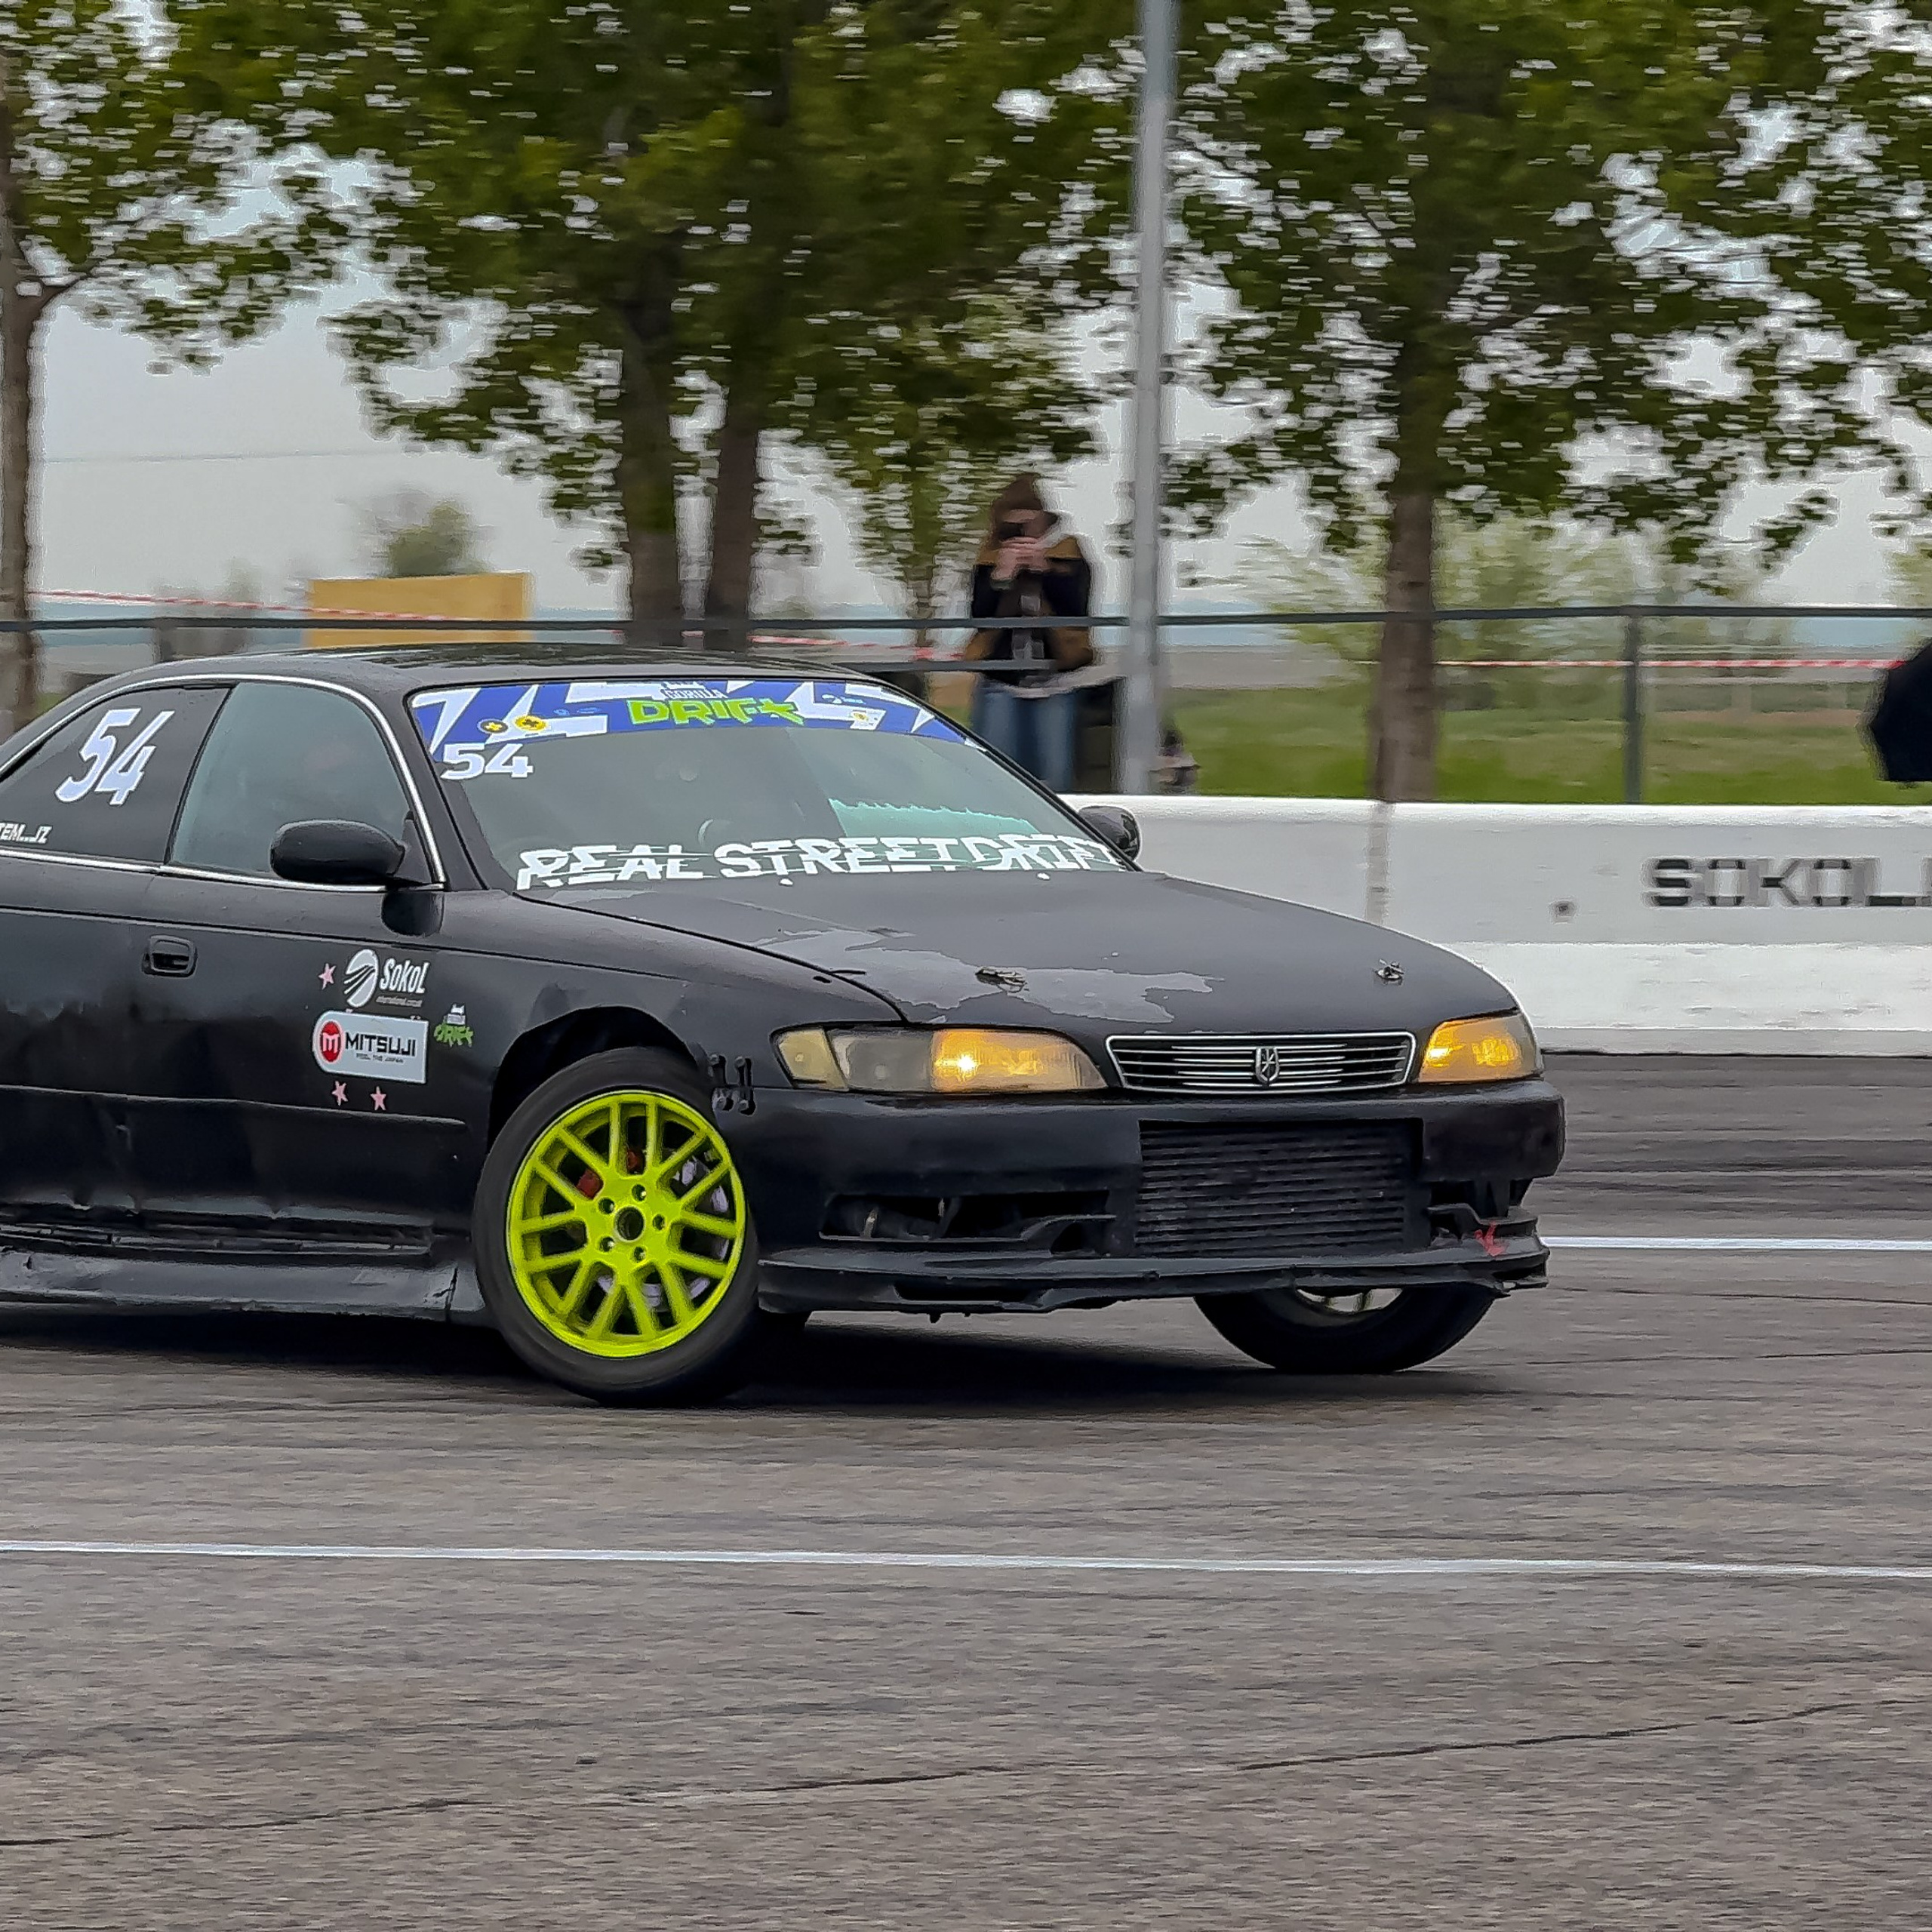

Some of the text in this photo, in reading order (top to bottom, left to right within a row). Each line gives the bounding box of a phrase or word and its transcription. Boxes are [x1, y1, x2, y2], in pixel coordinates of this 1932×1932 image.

[55, 708, 174, 805] 54
[440, 743, 533, 780] 54
[516, 844, 715, 890] REAL
[1648, 857, 1932, 906] SOKOL
[345, 1032, 417, 1057] MITSUJI
